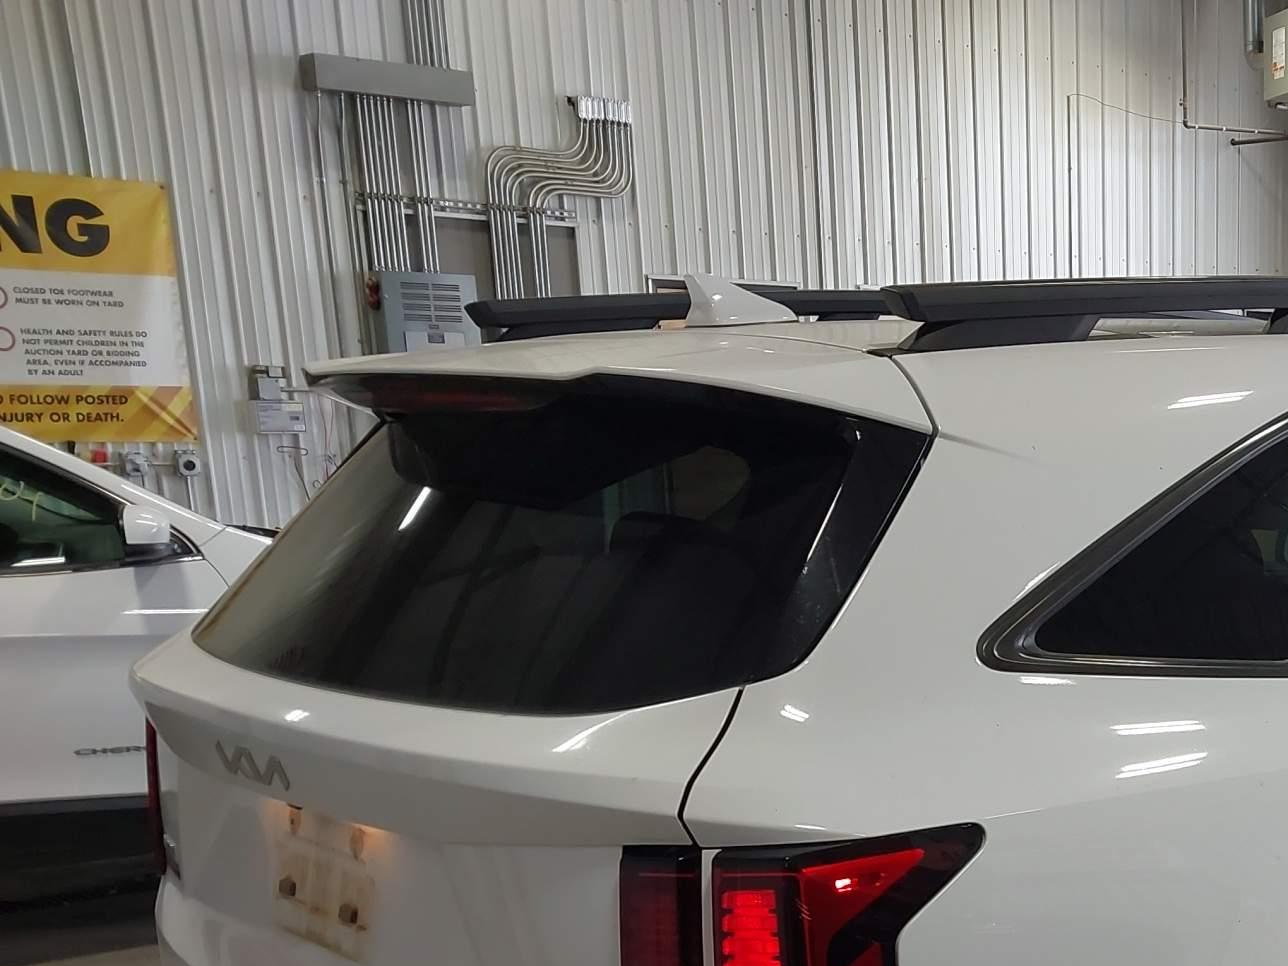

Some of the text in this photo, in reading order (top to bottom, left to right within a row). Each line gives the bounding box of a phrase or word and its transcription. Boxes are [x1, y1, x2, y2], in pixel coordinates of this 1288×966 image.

[13, 286, 113, 297] CLOSED TOE FOOTWEAR
[15, 297, 39, 305] MUST
[55, 298, 83, 306] WORN
[86, 299, 100, 307] ON
[102, 300, 124, 308] YARD
[20, 328, 53, 336] HEALTH
[55, 328, 75, 336] AND
[78, 329, 107, 337] SAFETY
[109, 330, 133, 338] RULES
[44, 338, 74, 346] PERMIT
[76, 339, 117, 347] CHILDREN
[131, 340, 145, 348] THE
[24, 348, 63, 356] AUCTION
[54, 359, 76, 367] EVEN
[78, 359, 86, 367] IF
[88, 359, 147, 367] ACCOMPANIED
[28, 368, 38, 376] BY
[9, 394, 70, 405] FOLLOW
[76, 394, 129, 405] POSTED
[49, 412, 71, 423] OR
[76, 412, 125, 422] DEATH.
